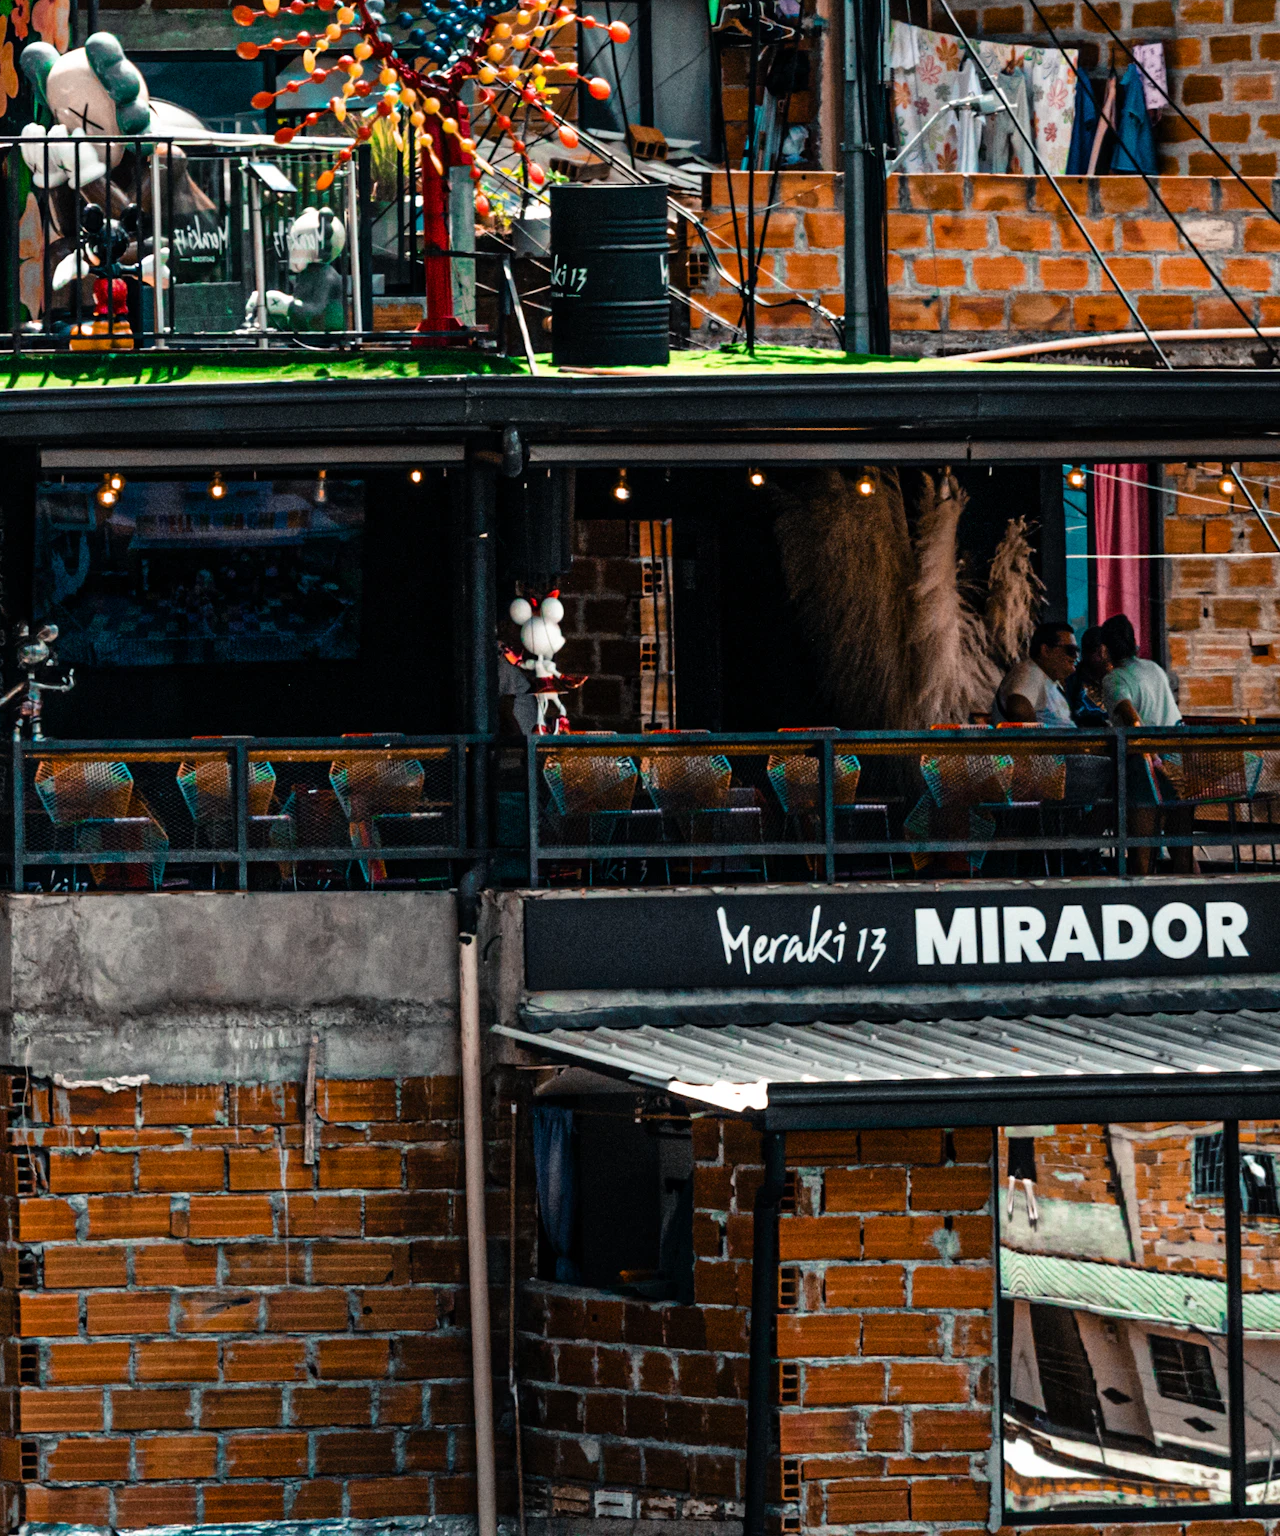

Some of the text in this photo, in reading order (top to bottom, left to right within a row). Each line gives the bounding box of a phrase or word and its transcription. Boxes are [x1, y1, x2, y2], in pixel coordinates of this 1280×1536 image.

[717, 902, 1249, 974] Meraki 13 MIRADOR
